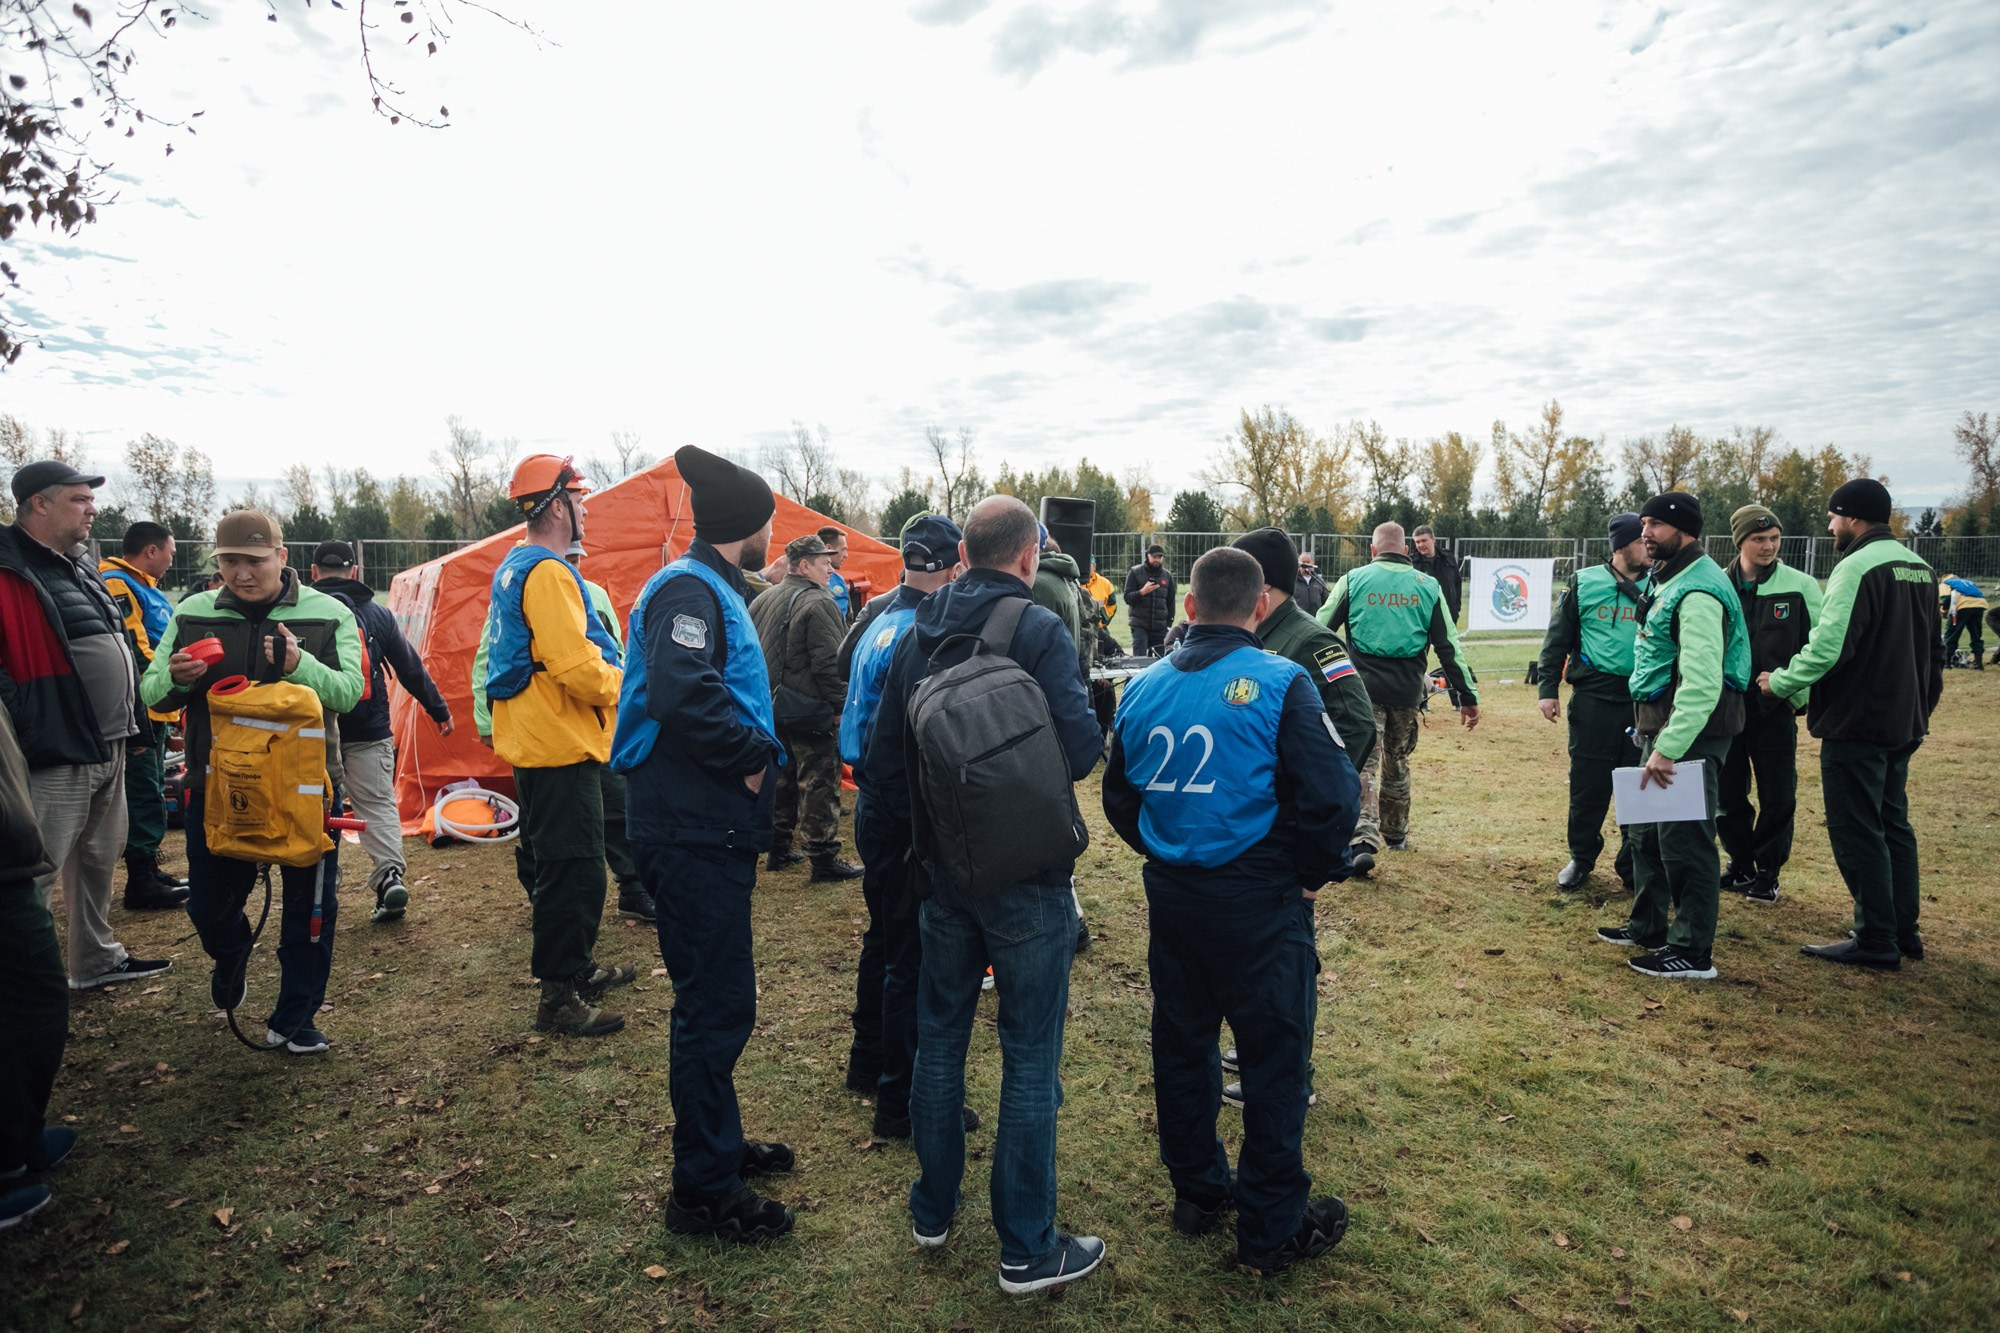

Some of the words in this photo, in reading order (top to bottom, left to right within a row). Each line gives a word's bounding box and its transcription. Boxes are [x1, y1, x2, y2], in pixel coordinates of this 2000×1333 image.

[1367, 592, 1419, 607] СУДЬЯ
[1598, 606, 1635, 622] СУД
[1145, 724, 1216, 794] 22
